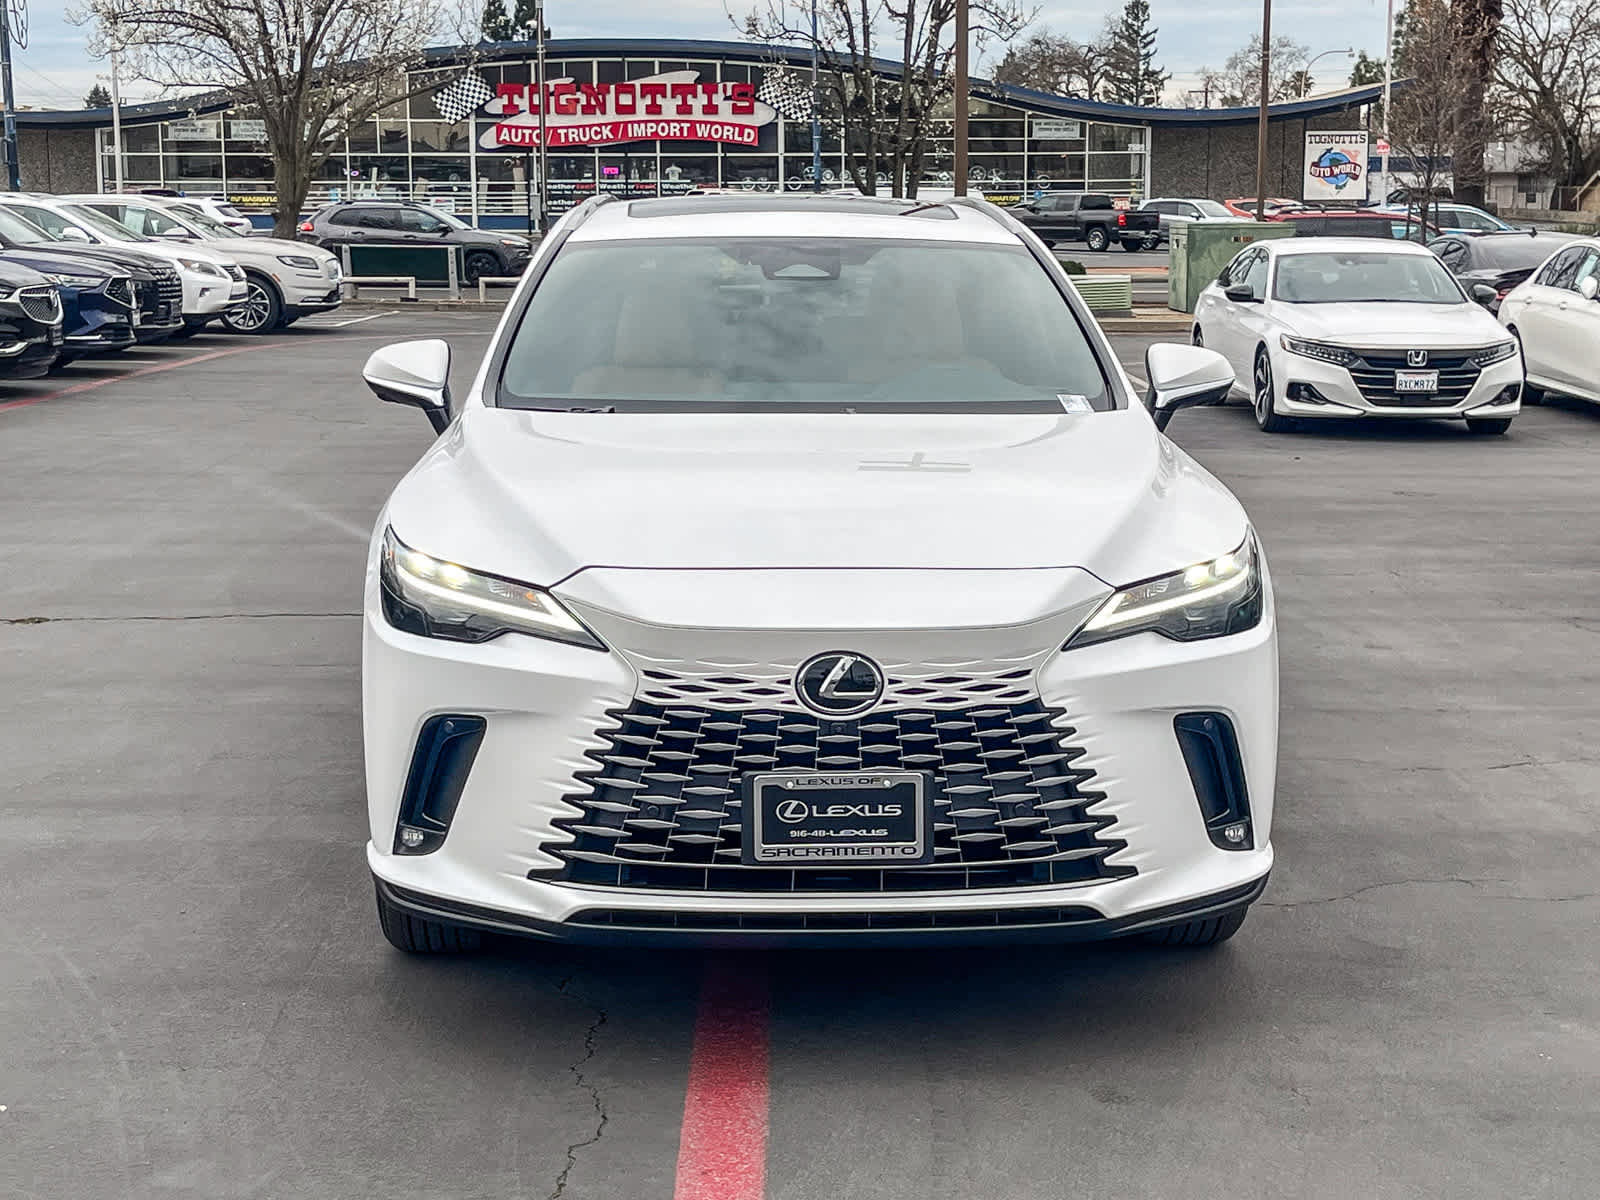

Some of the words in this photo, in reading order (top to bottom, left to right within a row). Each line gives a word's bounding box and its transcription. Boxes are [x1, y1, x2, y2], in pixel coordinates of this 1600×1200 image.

[496, 83, 755, 115] TOGNOTTI'S
[557, 124, 614, 143] TRUCK
[628, 122, 691, 139] IMPORT
[694, 123, 755, 143] WORLD
[1308, 134, 1366, 144] TOGNOTTI'S
[1311, 166, 1330, 177] AUTO
[1332, 163, 1362, 176] WORLD
[796, 777, 854, 786] LEXUS
[857, 777, 882, 785] OF
[812, 803, 903, 817] LEXUS
[761, 846, 917, 859] SACRAMENTO
